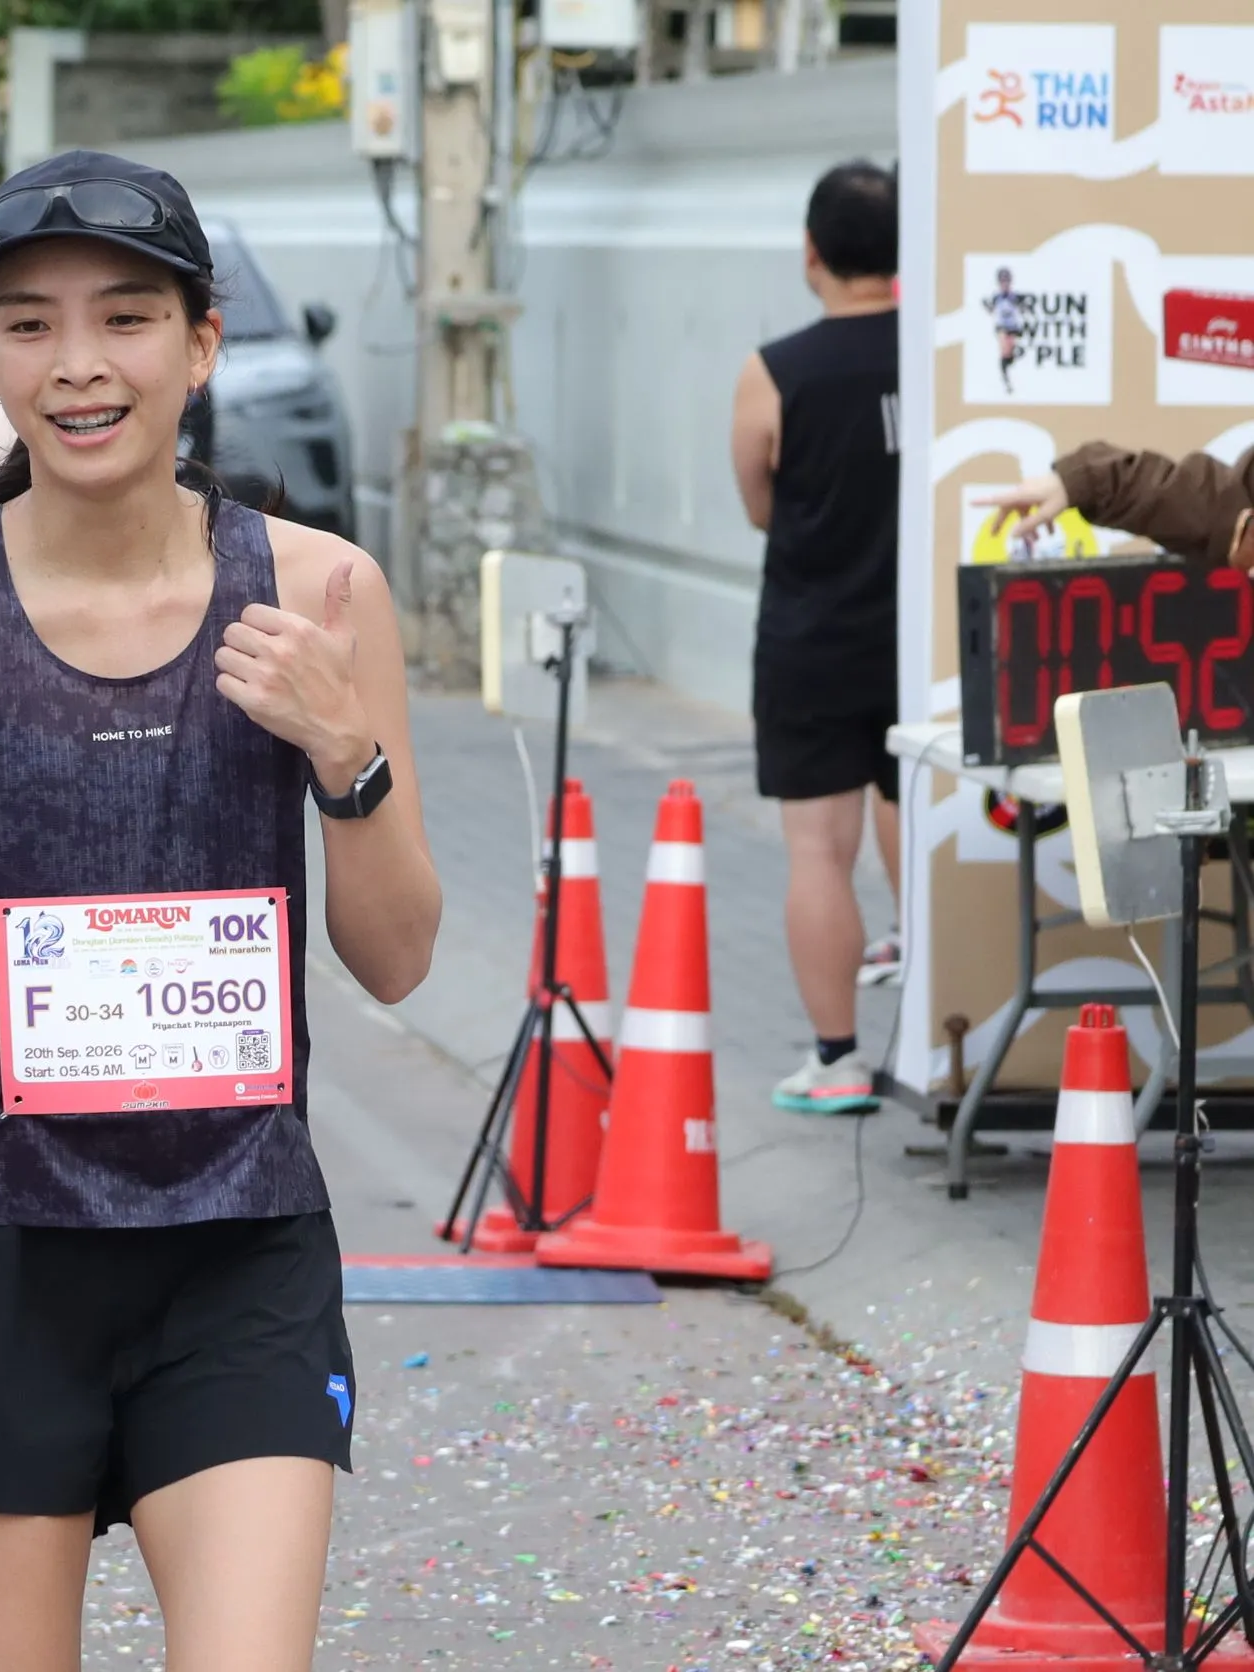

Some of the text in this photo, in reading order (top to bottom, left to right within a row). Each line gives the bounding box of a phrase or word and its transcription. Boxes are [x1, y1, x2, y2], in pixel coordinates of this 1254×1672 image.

[1033, 72, 1108, 97] THAI
[1038, 102, 1107, 128] RUN
[1019, 293, 1086, 315] RUN
[1016, 321, 1086, 338] WITH
[92, 725, 173, 742] HOME TO HIKE
[84, 906, 191, 932] LOMARUN
[209, 913, 269, 942] 10K
[209, 946, 227, 955] Mini
[229, 945, 271, 954] marathon
[26, 986, 52, 1027] F
[136, 978, 267, 1017] 10560
[65, 1003, 124, 1022] 30-34
[152, 1021, 192, 1031] Piyachat
[24, 1045, 123, 1062] 20th Sep. 2026
[138, 1056, 147, 1064] M
[169, 1056, 178, 1064] M
[24, 1064, 126, 1078] Start: 05:45 AM.
